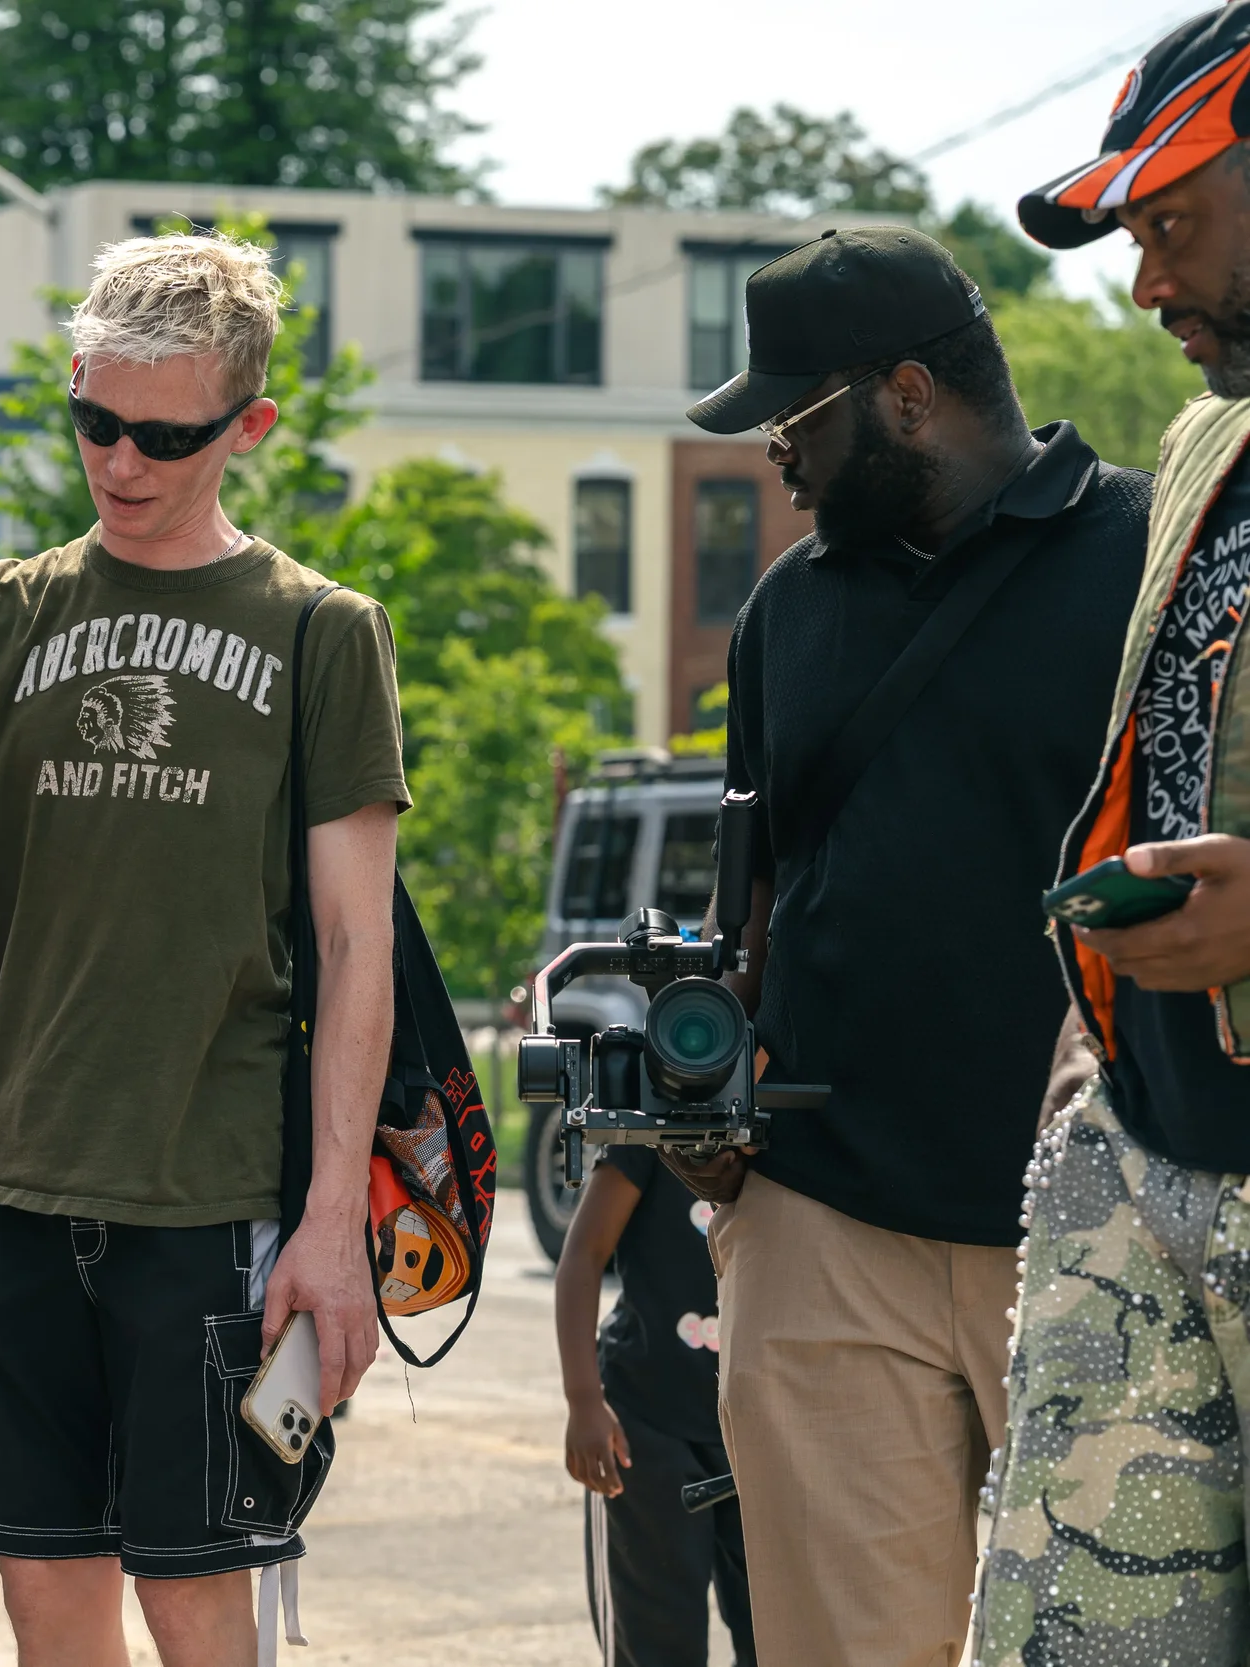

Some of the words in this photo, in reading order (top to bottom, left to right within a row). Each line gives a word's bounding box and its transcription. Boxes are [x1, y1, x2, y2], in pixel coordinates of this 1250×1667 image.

[14, 613, 283, 717] ABERCROMBIE
[36, 760, 103, 797] AND
[110, 762, 210, 805] FITCH
